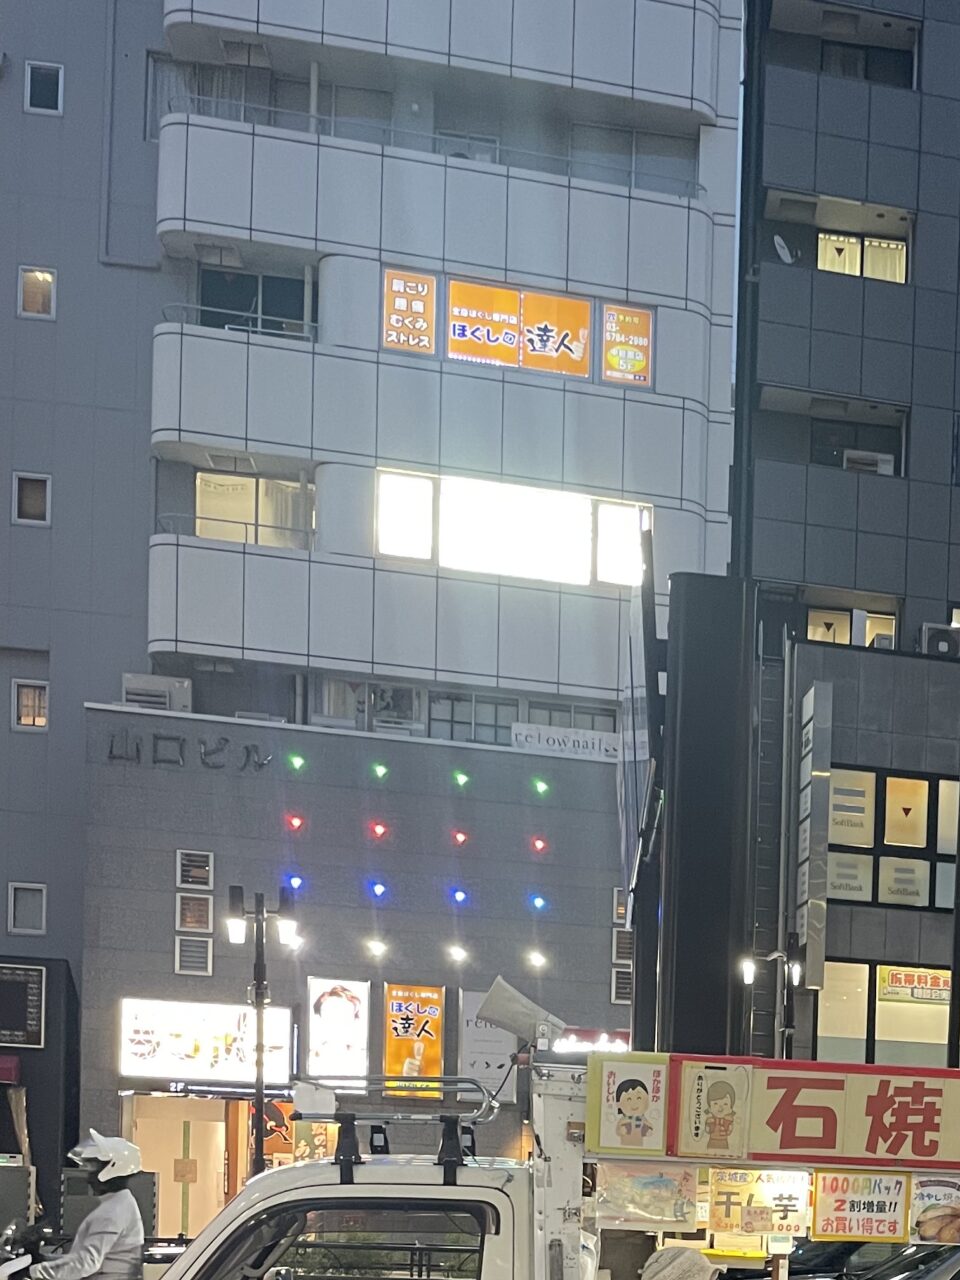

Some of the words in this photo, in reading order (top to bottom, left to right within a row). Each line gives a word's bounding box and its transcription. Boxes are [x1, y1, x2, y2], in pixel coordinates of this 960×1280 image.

[389, 314, 428, 331] むくみ
[386, 330, 430, 348] ストレス
[525, 323, 576, 354] 達人
[108, 730, 273, 772] 山口ビル
[391, 1014, 435, 1039] 達人
[170, 1082, 185, 1092] 2F
[821, 1175, 903, 1195] 1000円パック
[821, 1217, 900, 1235] お買い得です
